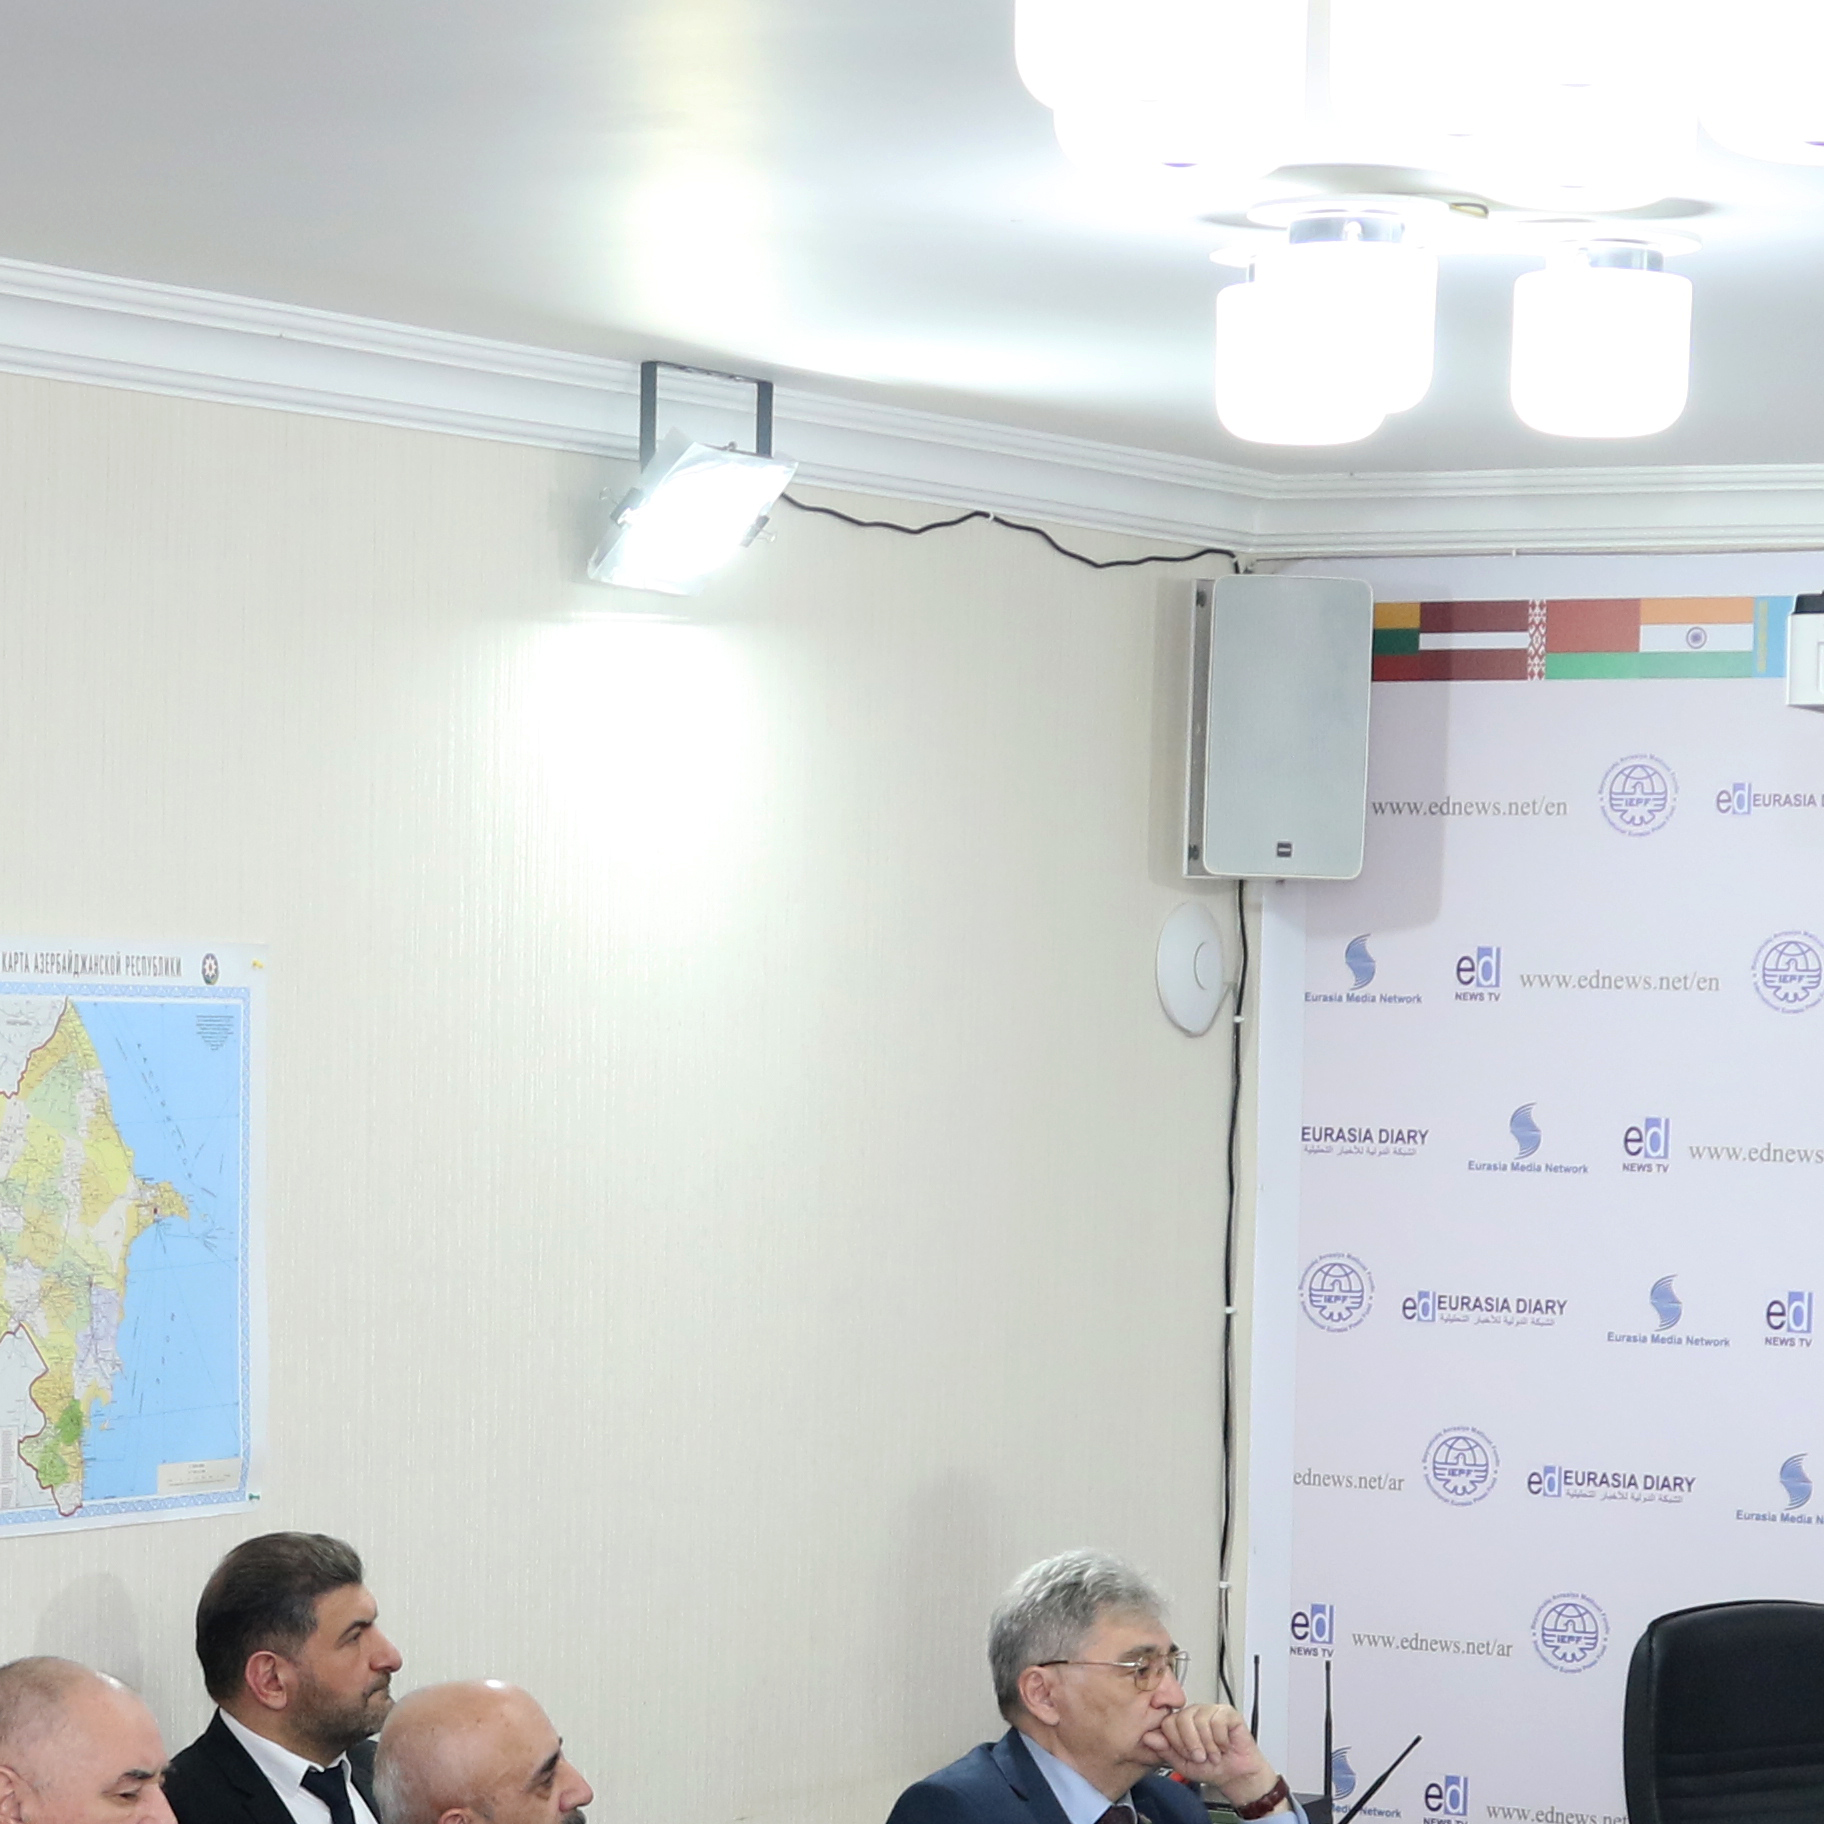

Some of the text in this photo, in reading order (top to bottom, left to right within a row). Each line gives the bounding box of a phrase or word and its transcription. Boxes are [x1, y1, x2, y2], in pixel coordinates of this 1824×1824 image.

[1371, 798, 1566, 818] www.ednews.net/en
[1754, 794, 1817, 807] EURASIA
[2, 952, 29, 973] КАРТА
[34, 950, 121, 978] АЗЕРБАЙДЖАНСКОЙ
[126, 955, 181, 977] РЕСПУБЛИКИ
[1519, 969, 1719, 991] www.ednews.net/en
[1301, 1126, 1428, 1144] EURASIA DIARY
[1438, 1295, 1511, 1312] EURASIA
[1516, 1298, 1567, 1315] DIARY
[1564, 1470, 1638, 1488] EURASIA
[1643, 1475, 1695, 1492] DIARY
[1290, 1646, 1334, 1657] NEWS TV
[1352, 1633, 1513, 1657] www.ednews.net/ar
